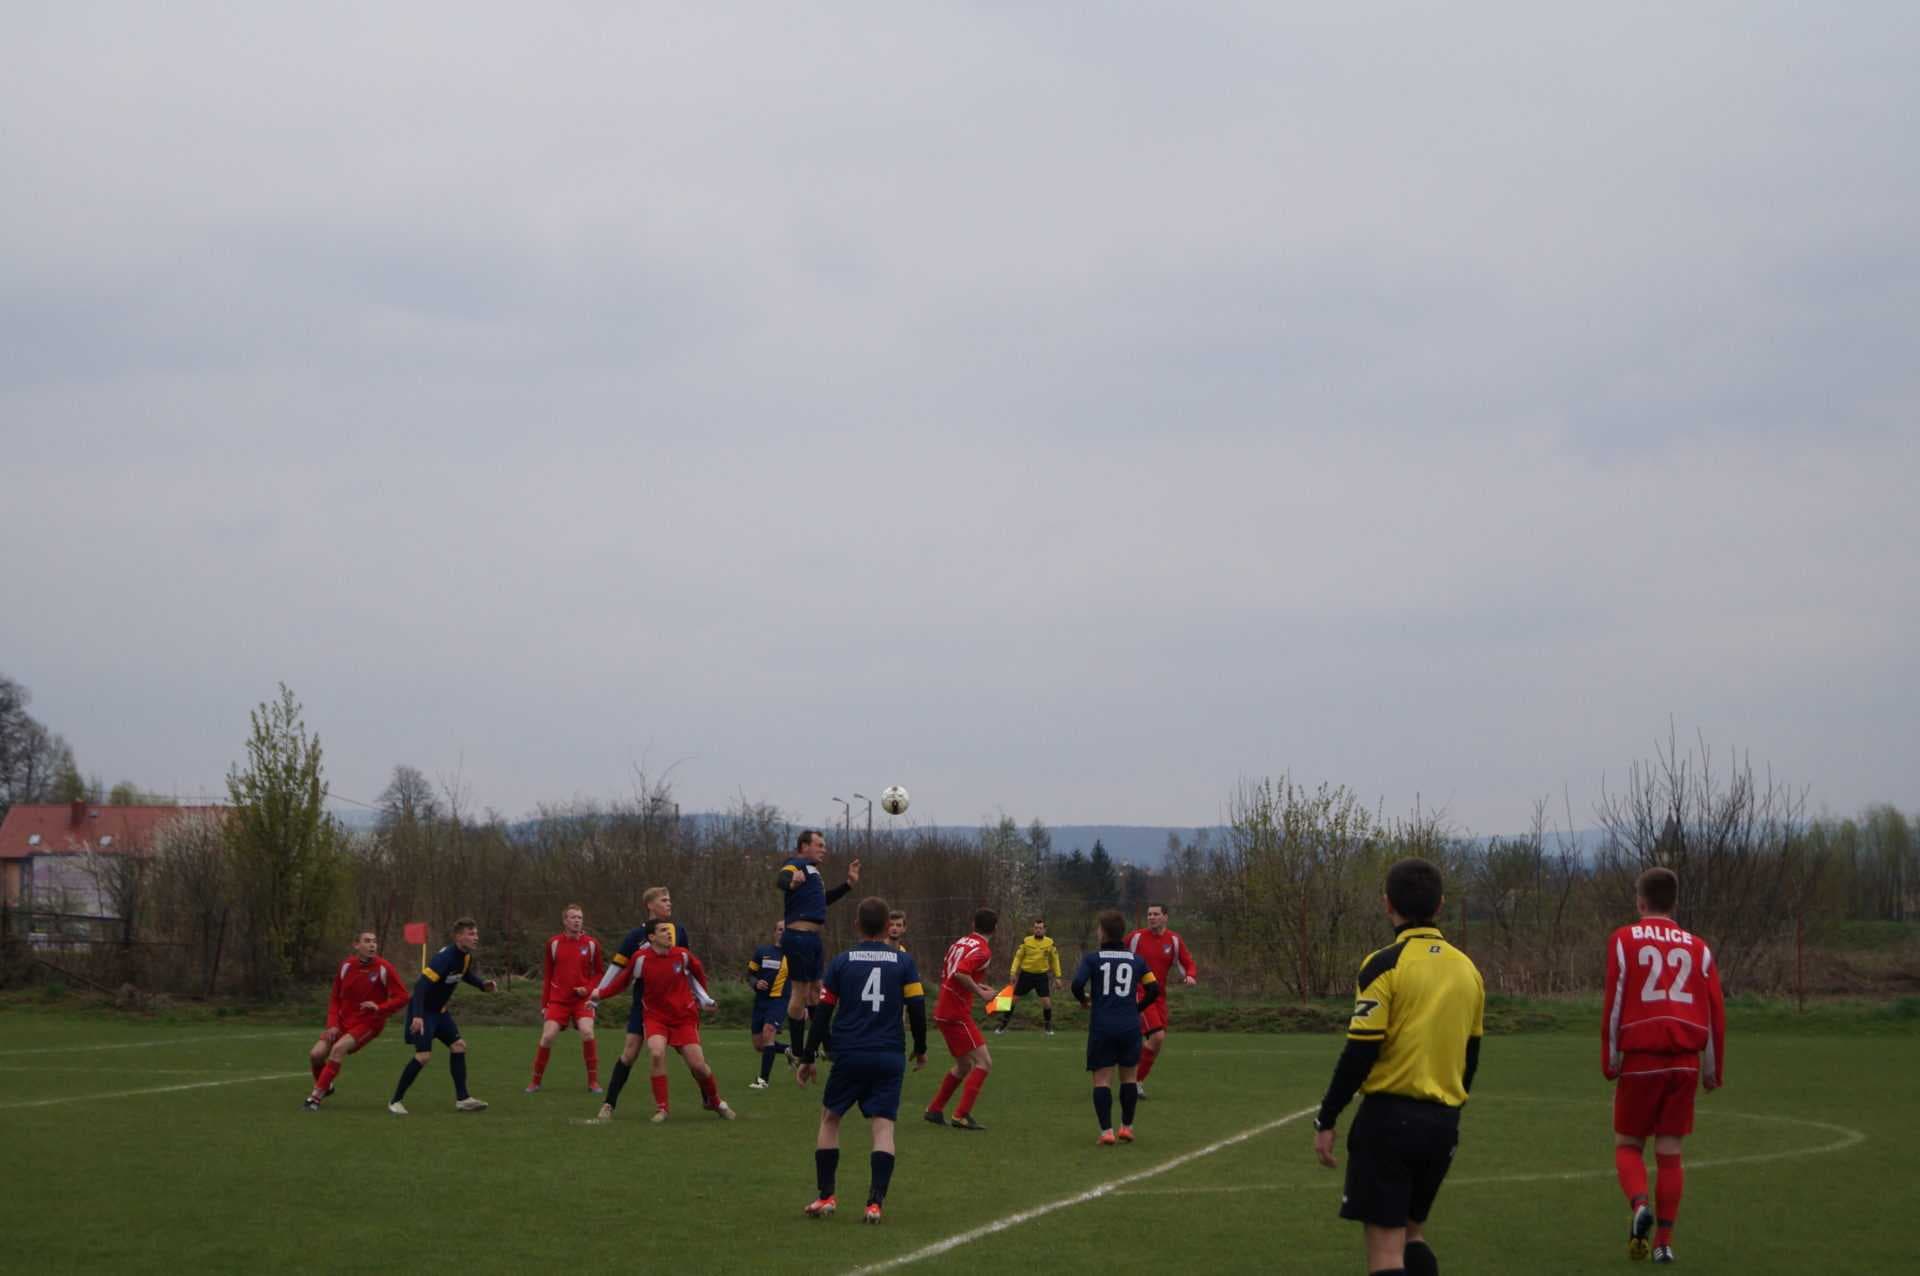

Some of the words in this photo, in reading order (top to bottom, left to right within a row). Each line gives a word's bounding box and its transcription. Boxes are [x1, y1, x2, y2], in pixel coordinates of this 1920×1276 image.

[1631, 925, 1693, 945] BALICE
[861, 967, 885, 1012] 4
[1100, 962, 1133, 997] 19
[1638, 945, 1693, 1004] 22
